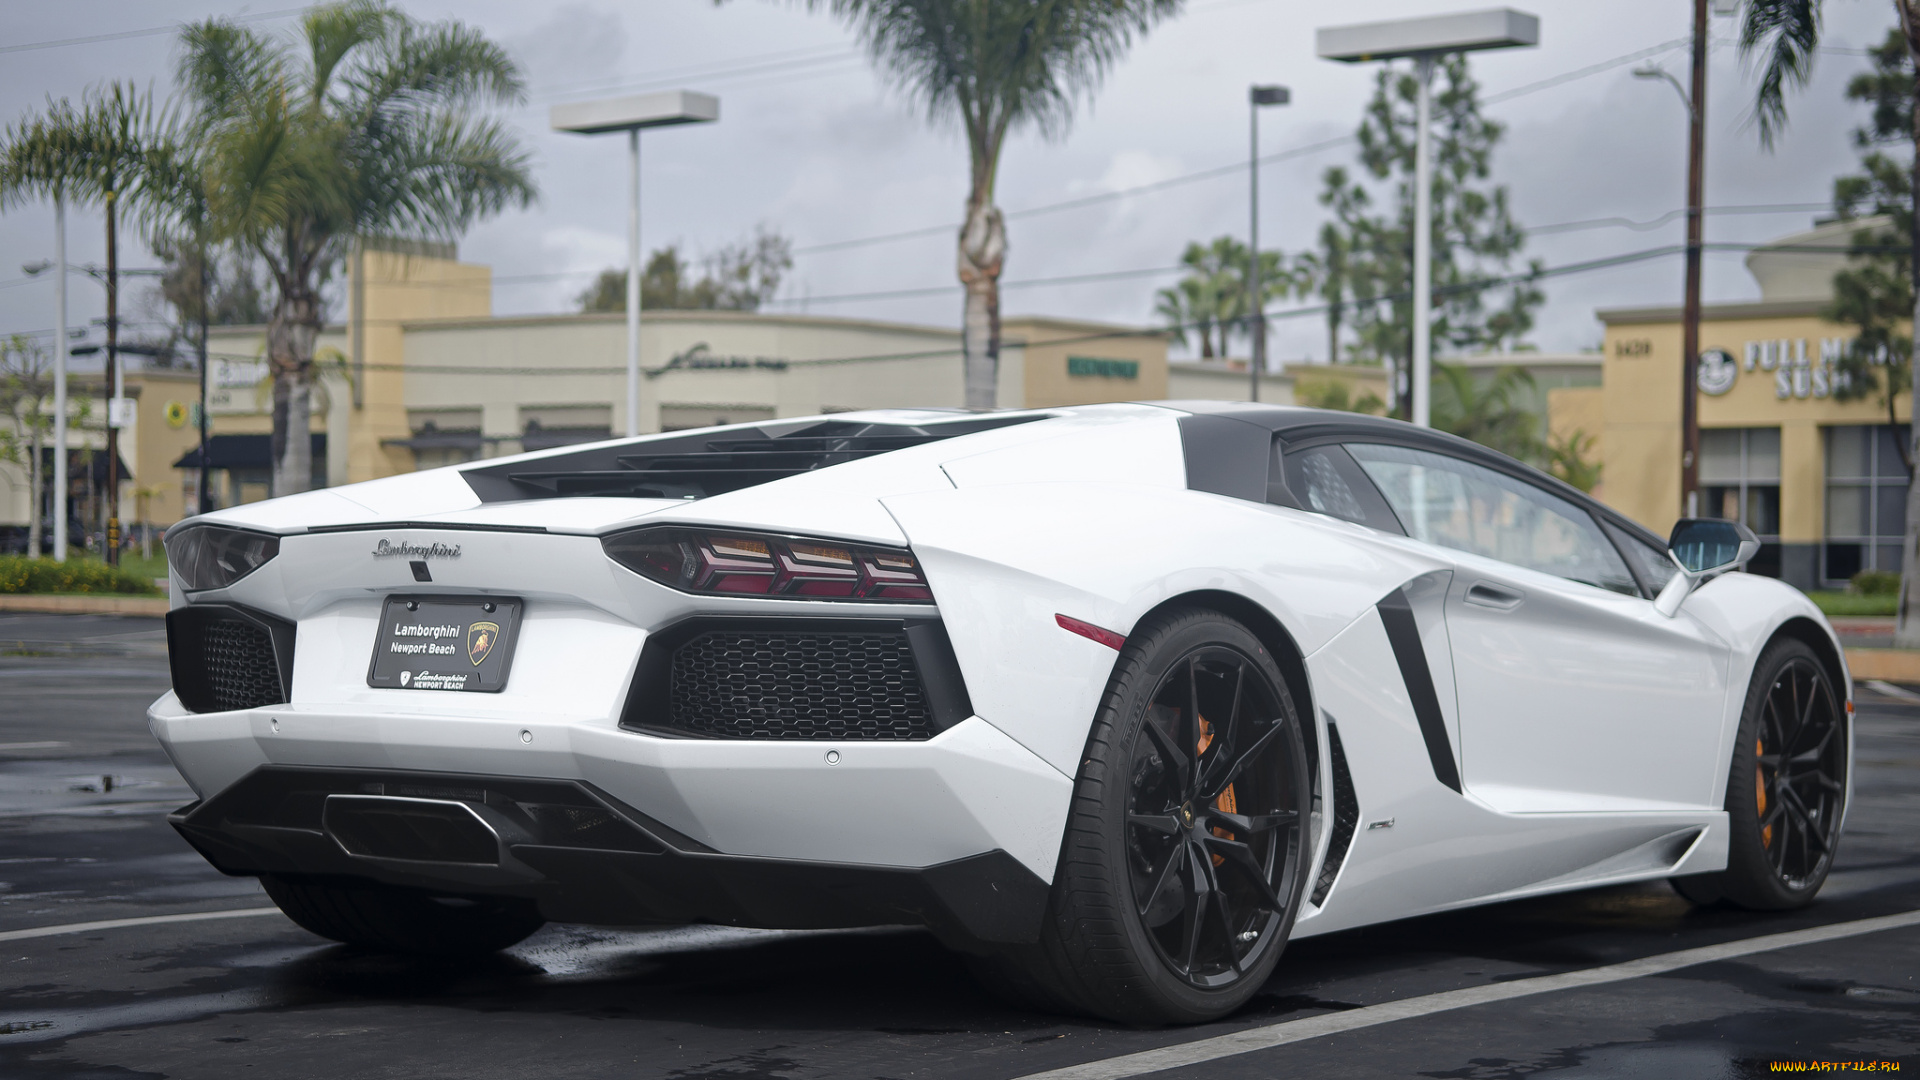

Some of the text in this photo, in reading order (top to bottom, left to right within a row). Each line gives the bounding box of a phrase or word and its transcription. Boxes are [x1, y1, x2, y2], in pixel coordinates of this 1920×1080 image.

[1744, 338, 1810, 372] FULL
[1776, 366, 1853, 398] SUSH
[372, 538, 461, 557] Lamborghini
[394, 623, 461, 640] Lamborghini
[391, 642, 456, 655] Newport Beach
[413, 670, 468, 682] Lamborghini
[413, 681, 464, 690] NEWPORT BEACH
